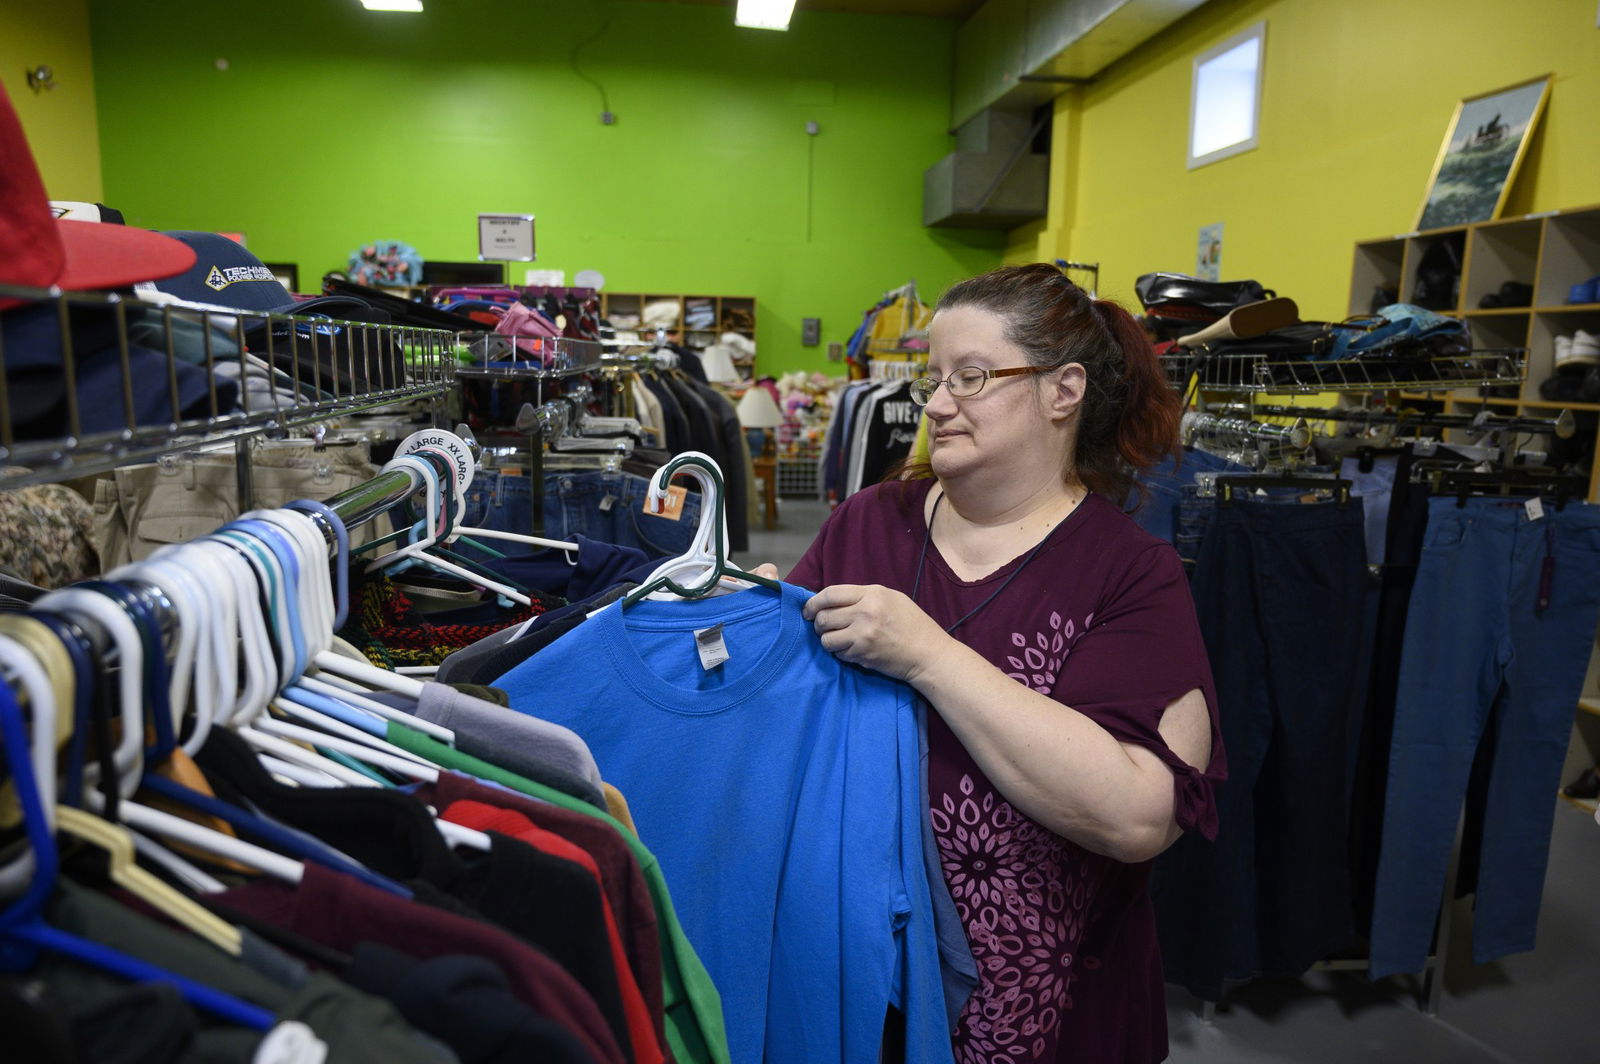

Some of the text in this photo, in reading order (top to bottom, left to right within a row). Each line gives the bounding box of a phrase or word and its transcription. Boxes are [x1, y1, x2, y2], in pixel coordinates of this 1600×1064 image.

[223, 266, 273, 276] TECHME
[411, 437, 444, 450] LARGE
[448, 443, 460, 455] XX
[456, 455, 467, 485] LARG
